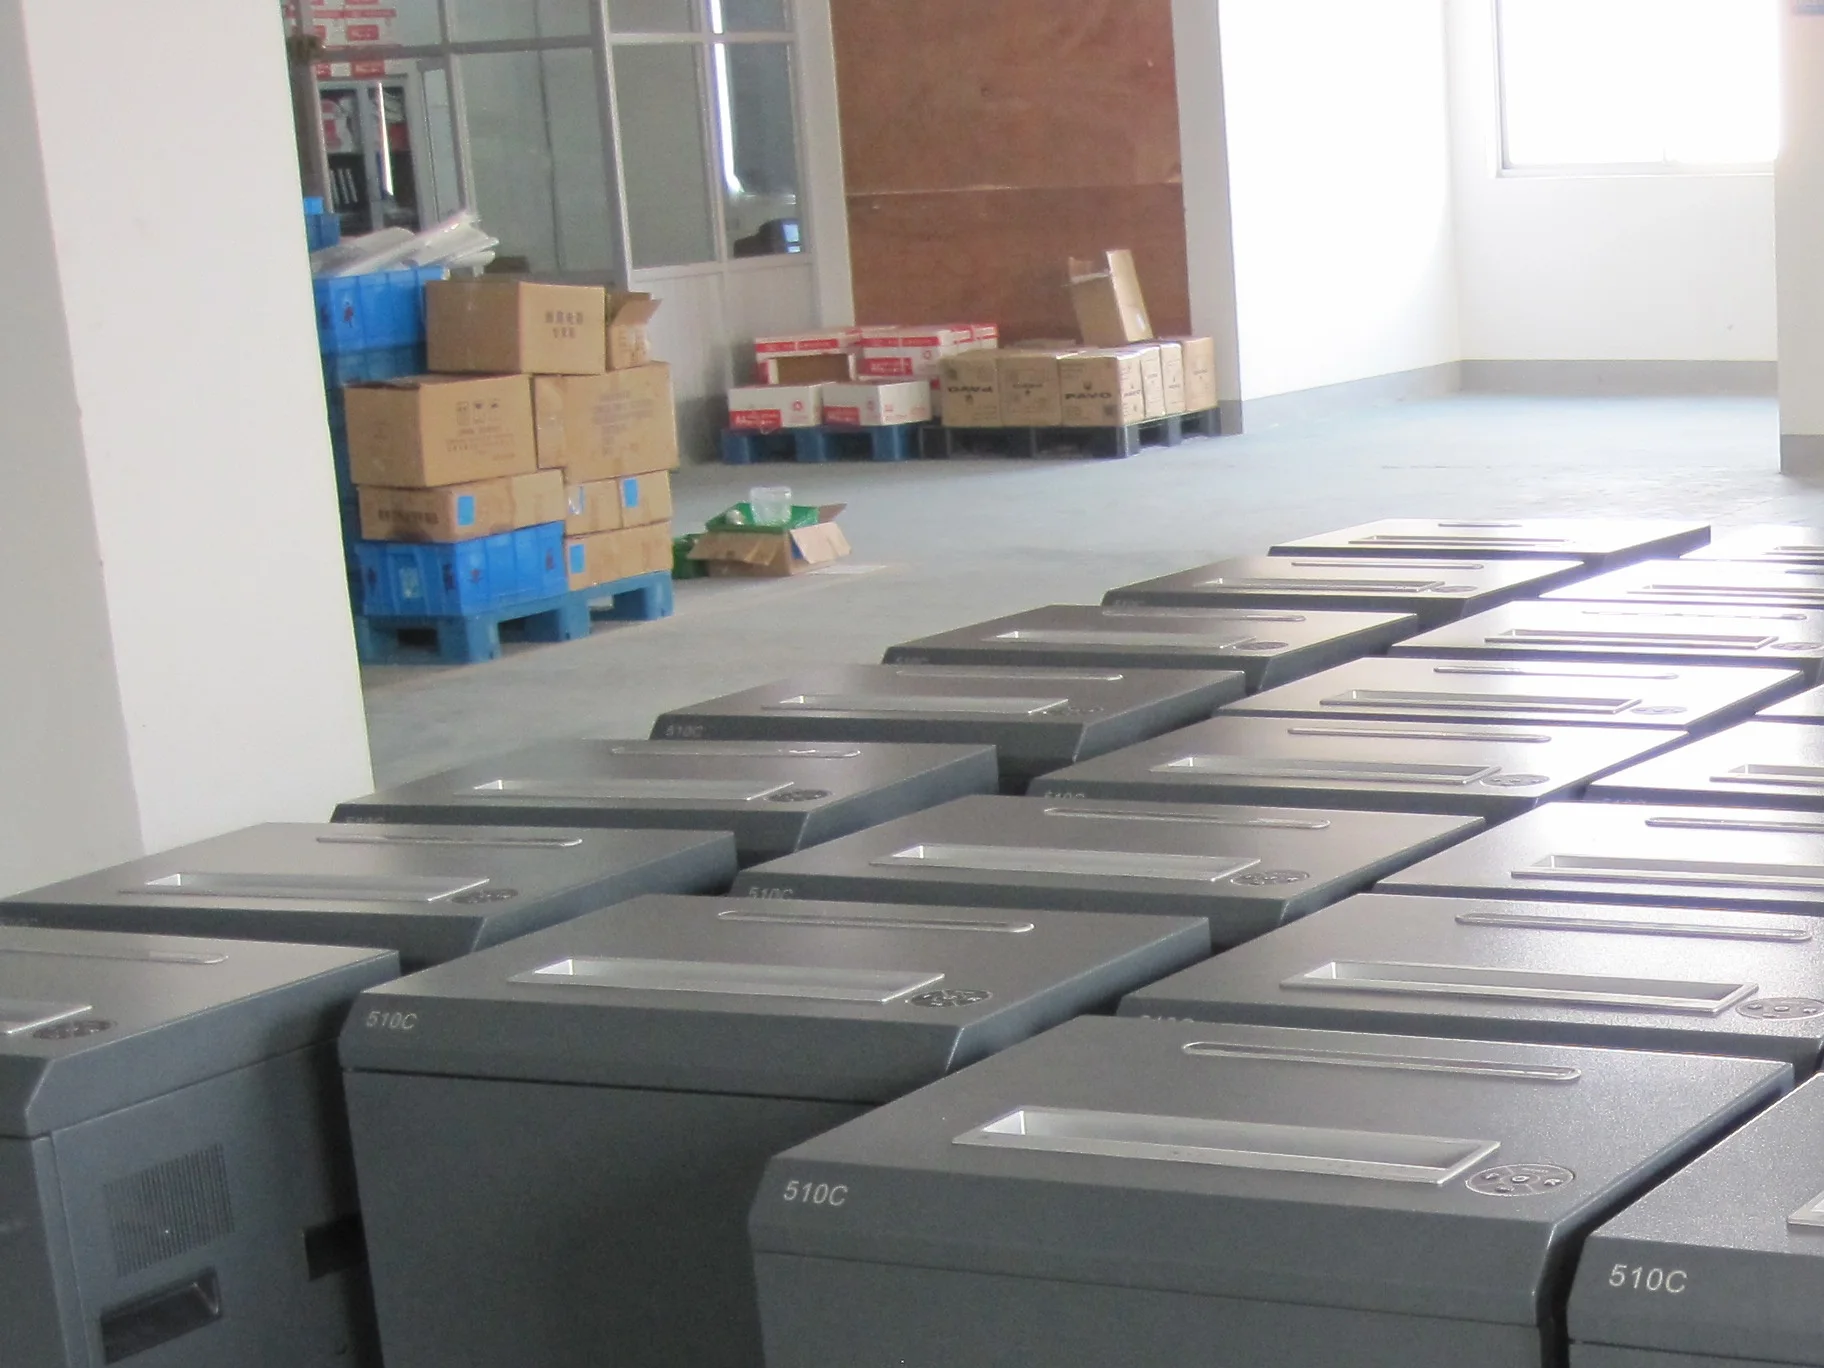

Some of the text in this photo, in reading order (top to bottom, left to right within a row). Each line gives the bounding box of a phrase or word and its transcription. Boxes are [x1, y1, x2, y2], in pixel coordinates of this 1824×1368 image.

[1065, 392, 1112, 400] PAVO
[366, 1011, 418, 1030] 510C
[783, 1180, 849, 1206] 510C
[1609, 1263, 1688, 1293] 510C
